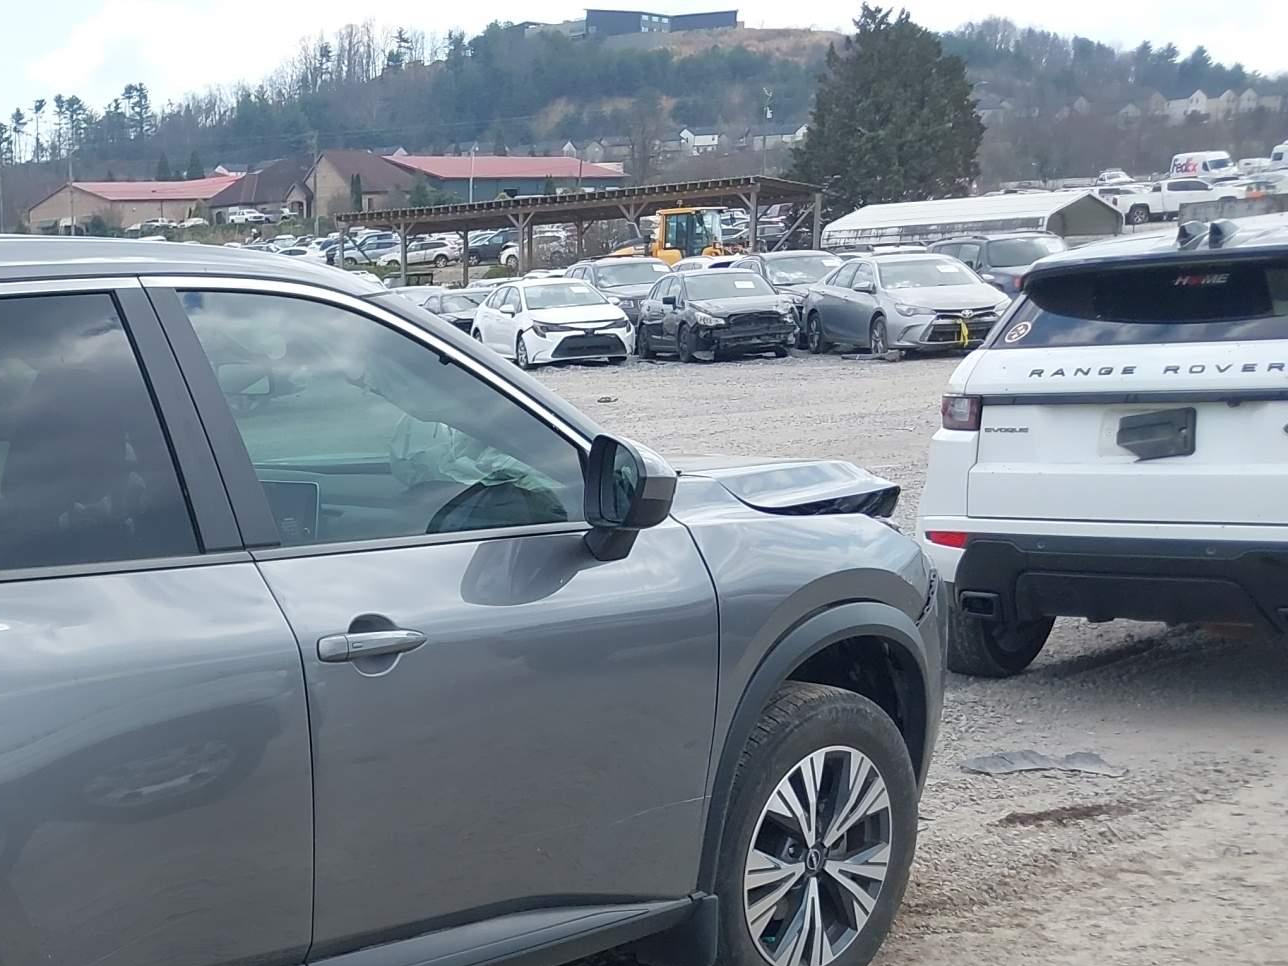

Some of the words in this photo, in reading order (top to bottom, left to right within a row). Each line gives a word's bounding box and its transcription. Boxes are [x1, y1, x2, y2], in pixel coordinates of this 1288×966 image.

[1173, 158, 1198, 173] FedEx
[1028, 366, 1137, 378] RANGE
[1163, 362, 1286, 375] ROVER
